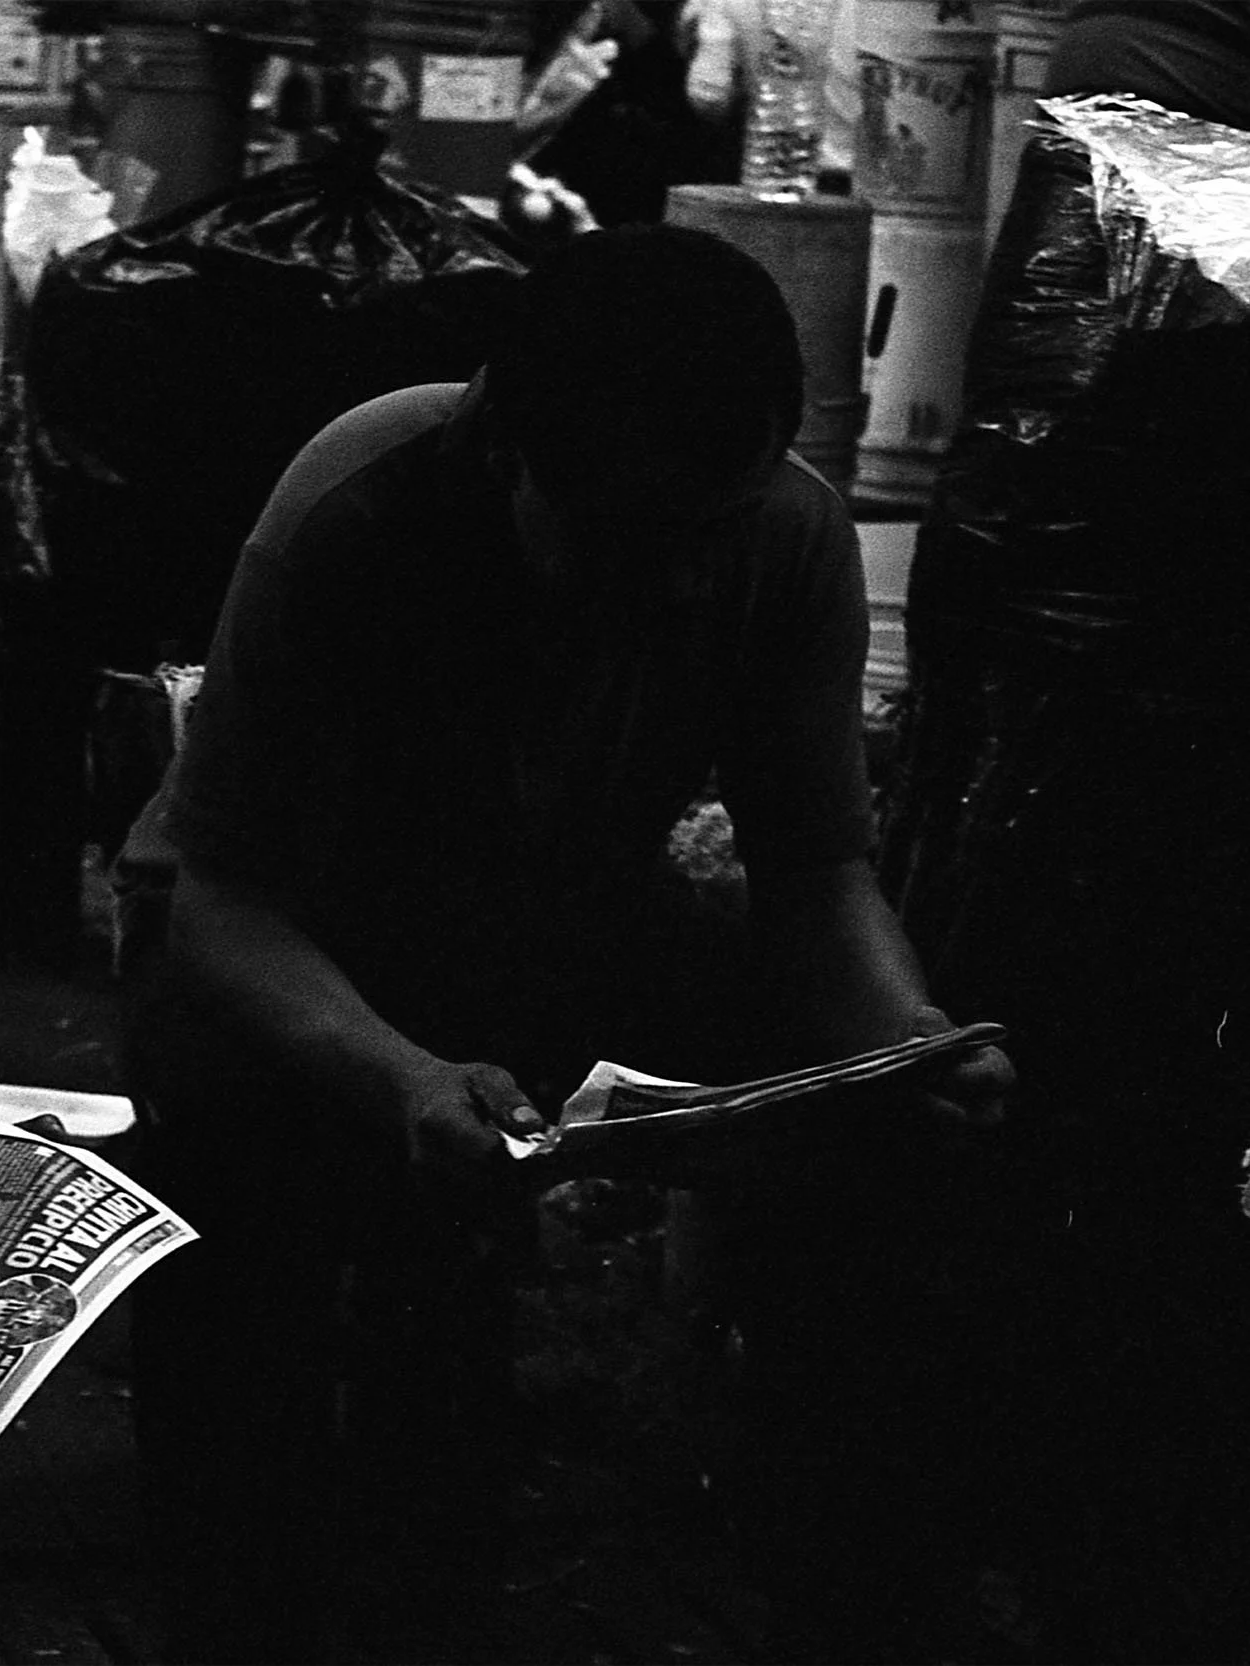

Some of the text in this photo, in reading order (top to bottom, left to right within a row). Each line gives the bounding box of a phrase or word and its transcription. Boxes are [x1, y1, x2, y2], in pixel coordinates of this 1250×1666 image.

[4, 1170, 117, 1269] PRECIPICIO
[61, 1191, 148, 1249] CHIVITA
[38, 1241, 87, 1273] AL
